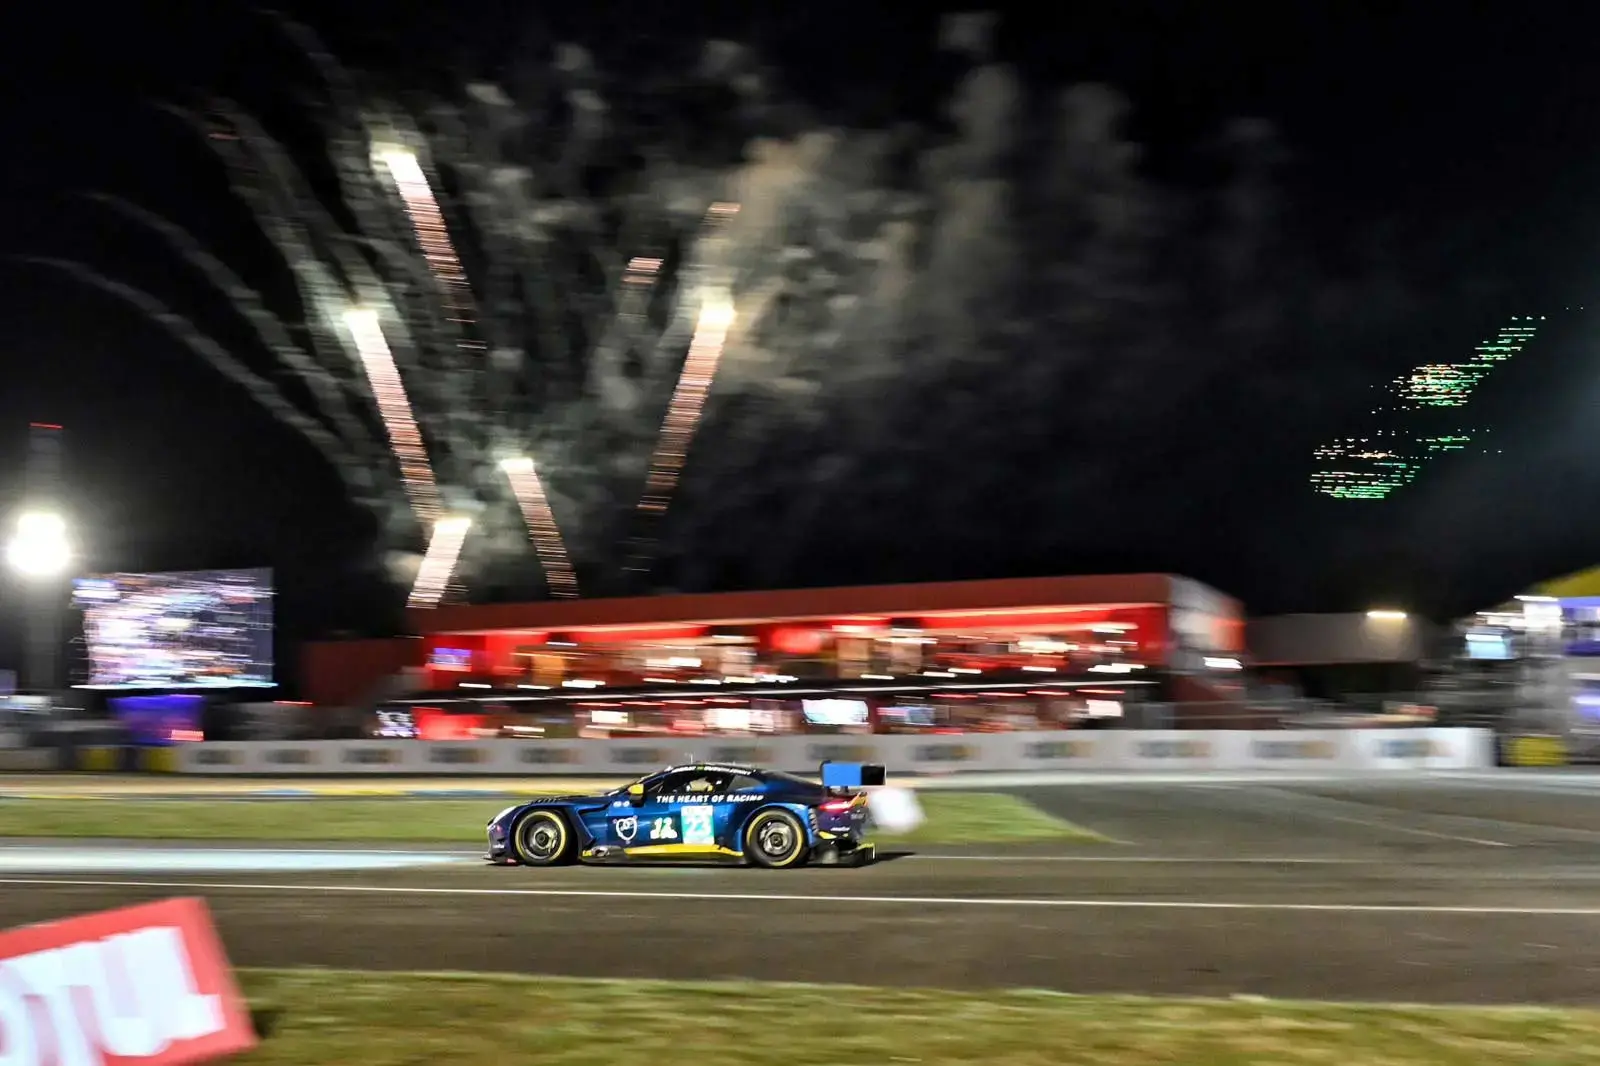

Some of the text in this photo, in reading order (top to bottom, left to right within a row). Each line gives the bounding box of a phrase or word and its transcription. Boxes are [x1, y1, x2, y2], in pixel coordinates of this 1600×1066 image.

[656, 794, 764, 803] THE HEART OF RACING
[686, 815, 711, 836] 23
